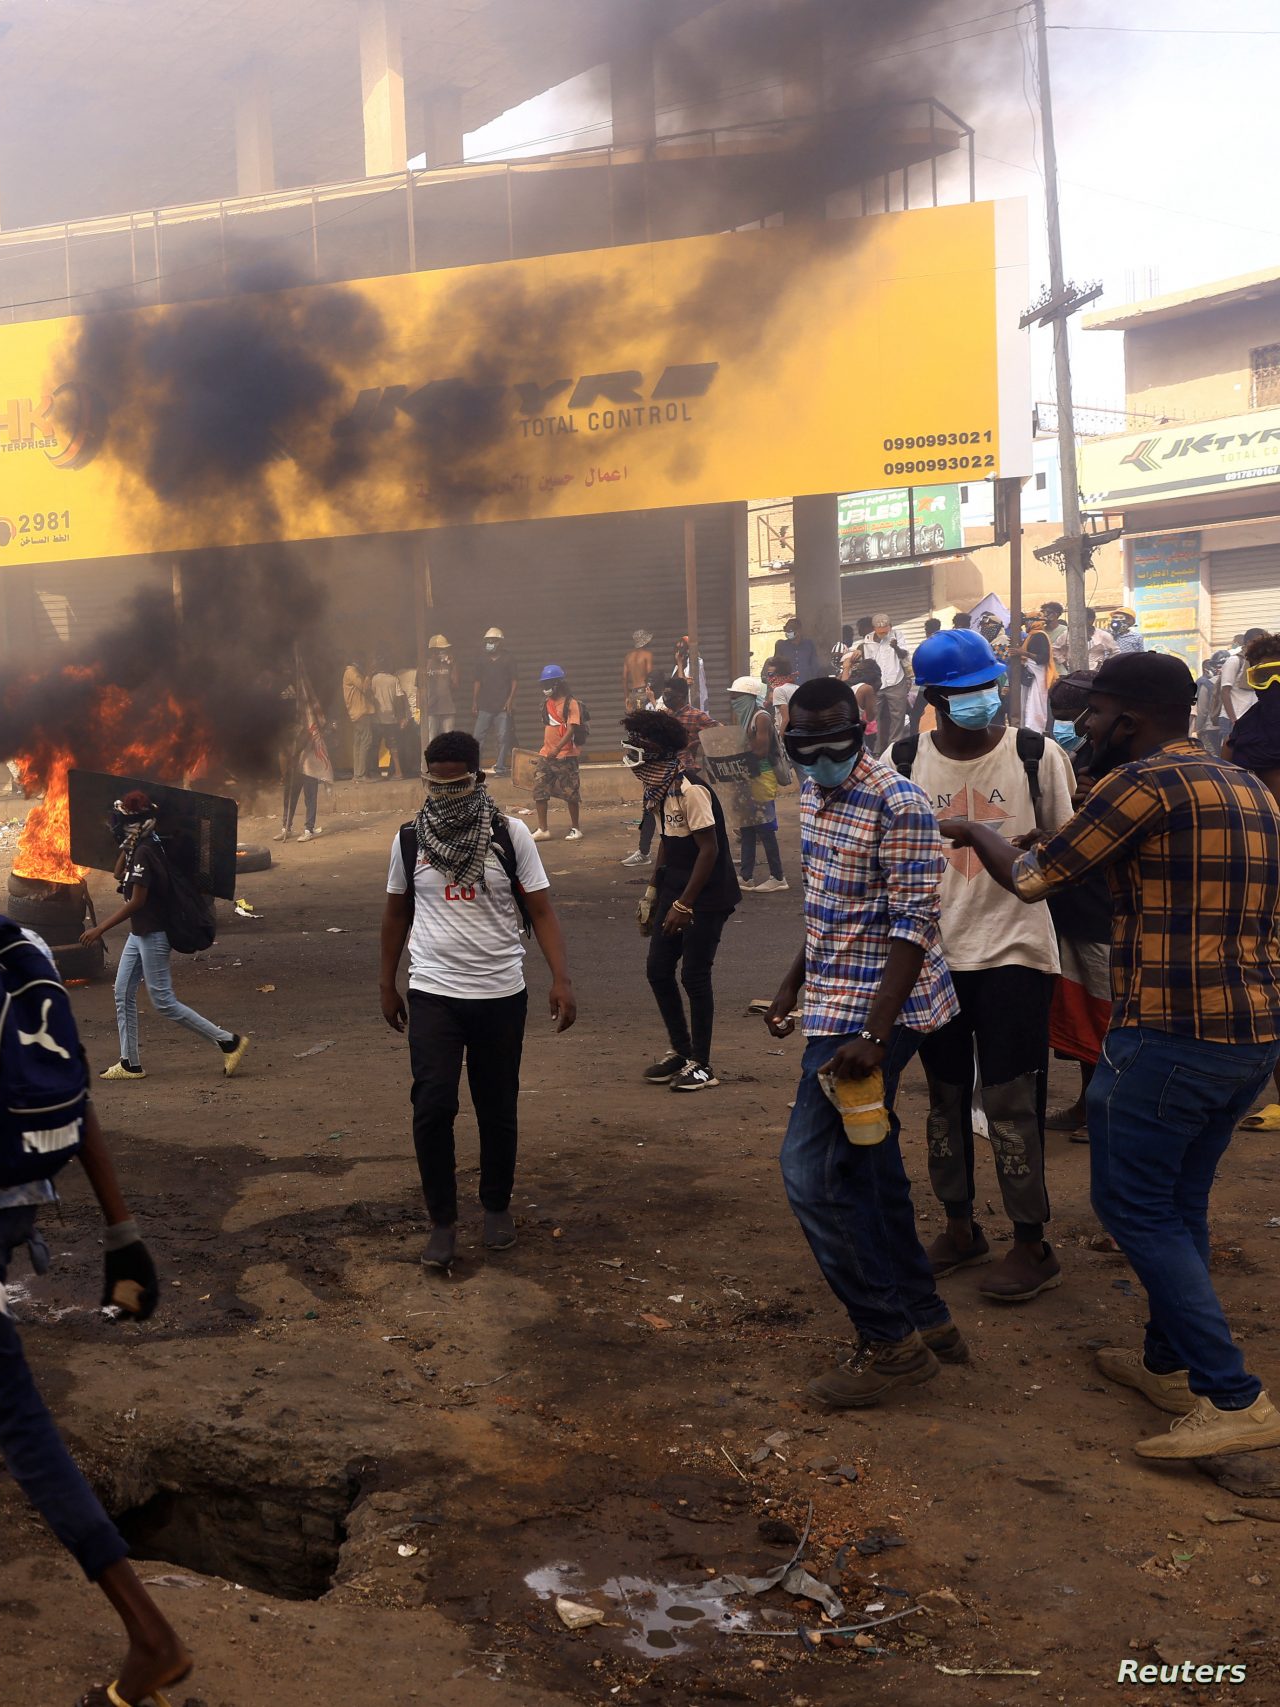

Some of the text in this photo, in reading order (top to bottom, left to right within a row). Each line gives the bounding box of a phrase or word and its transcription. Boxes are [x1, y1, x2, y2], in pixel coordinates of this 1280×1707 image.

[520, 402, 692, 438] TOTAL CONTROL
[883, 430, 991, 451] 0990993021
[884, 455, 994, 475] 0990993022
[1220, 448, 1256, 462] TOTAL
[19, 510, 70, 533] 2981
[715, 759, 742, 776] POLICE
